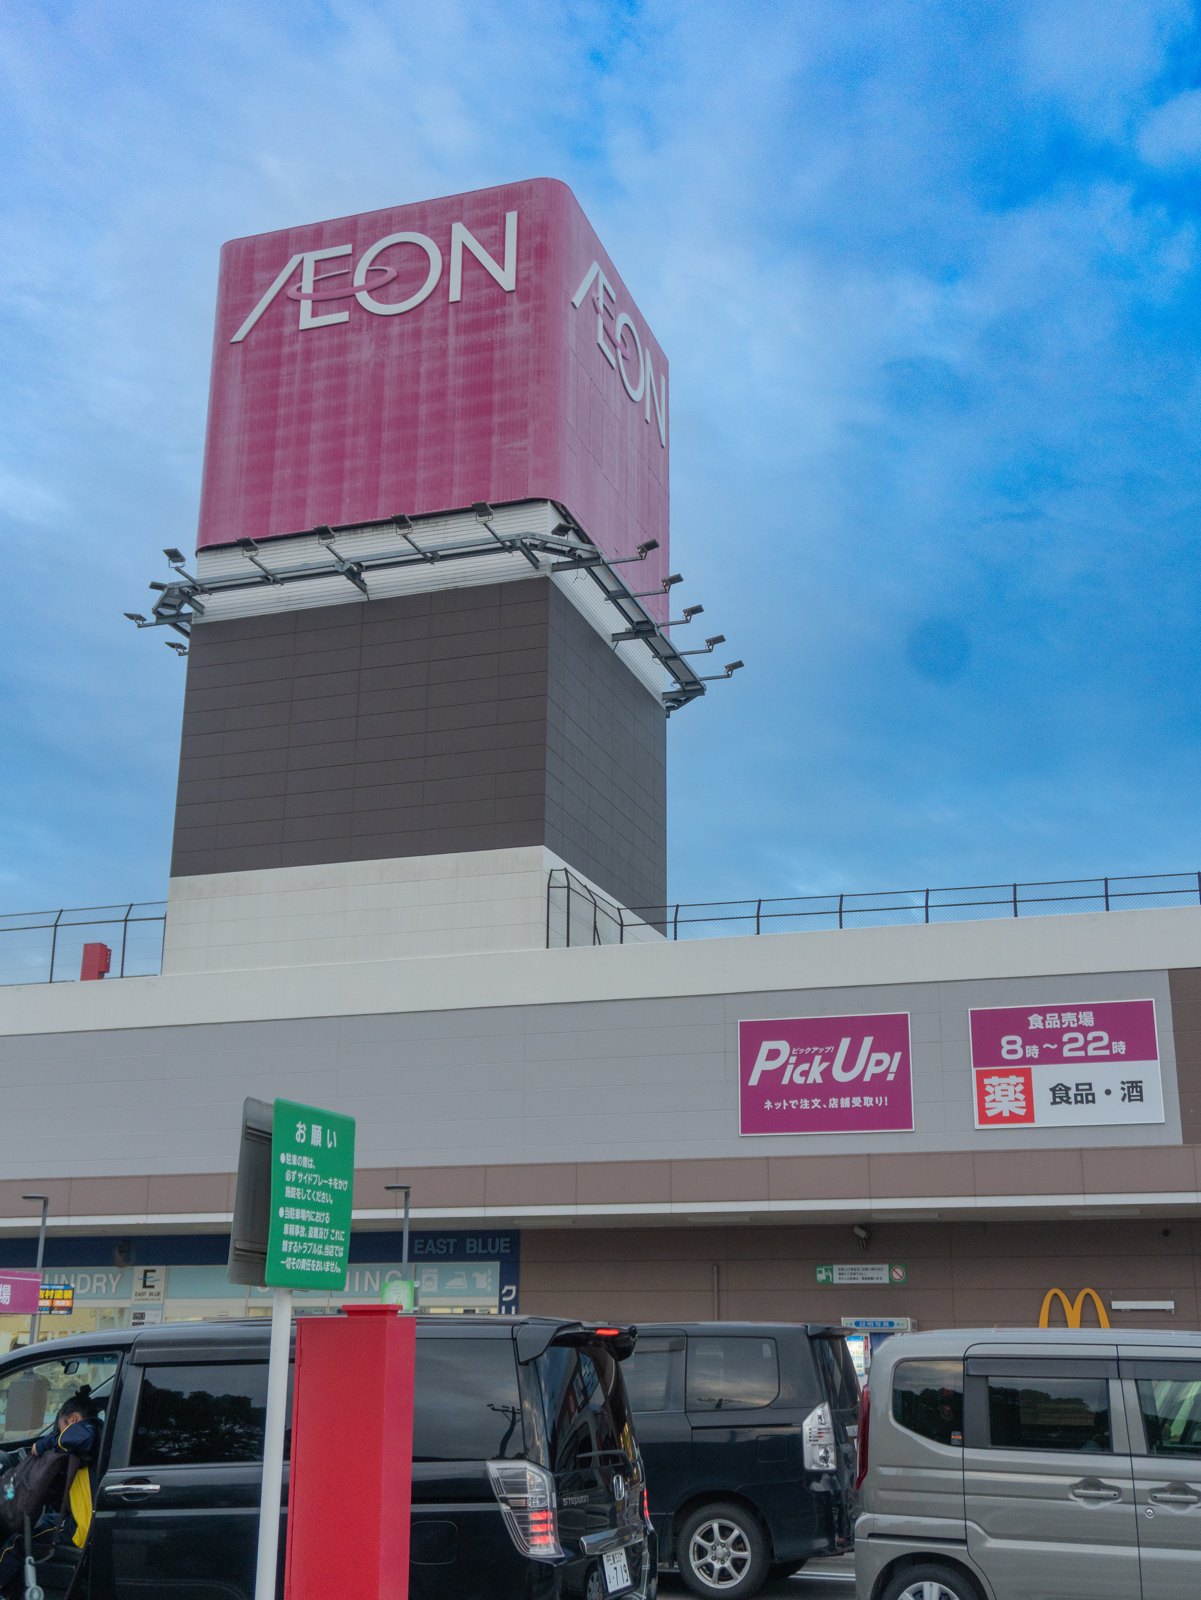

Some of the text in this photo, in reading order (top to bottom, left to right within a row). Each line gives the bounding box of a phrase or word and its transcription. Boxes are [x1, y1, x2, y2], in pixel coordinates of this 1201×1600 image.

[1028, 1011, 1095, 1030] 食品売場
[983, 1075, 1027, 1117] 薬
[1049, 1080, 1144, 1106] 食品・酒
[295, 1121, 337, 1149] お願い
[414, 1237, 511, 1255] EAST BLUE
